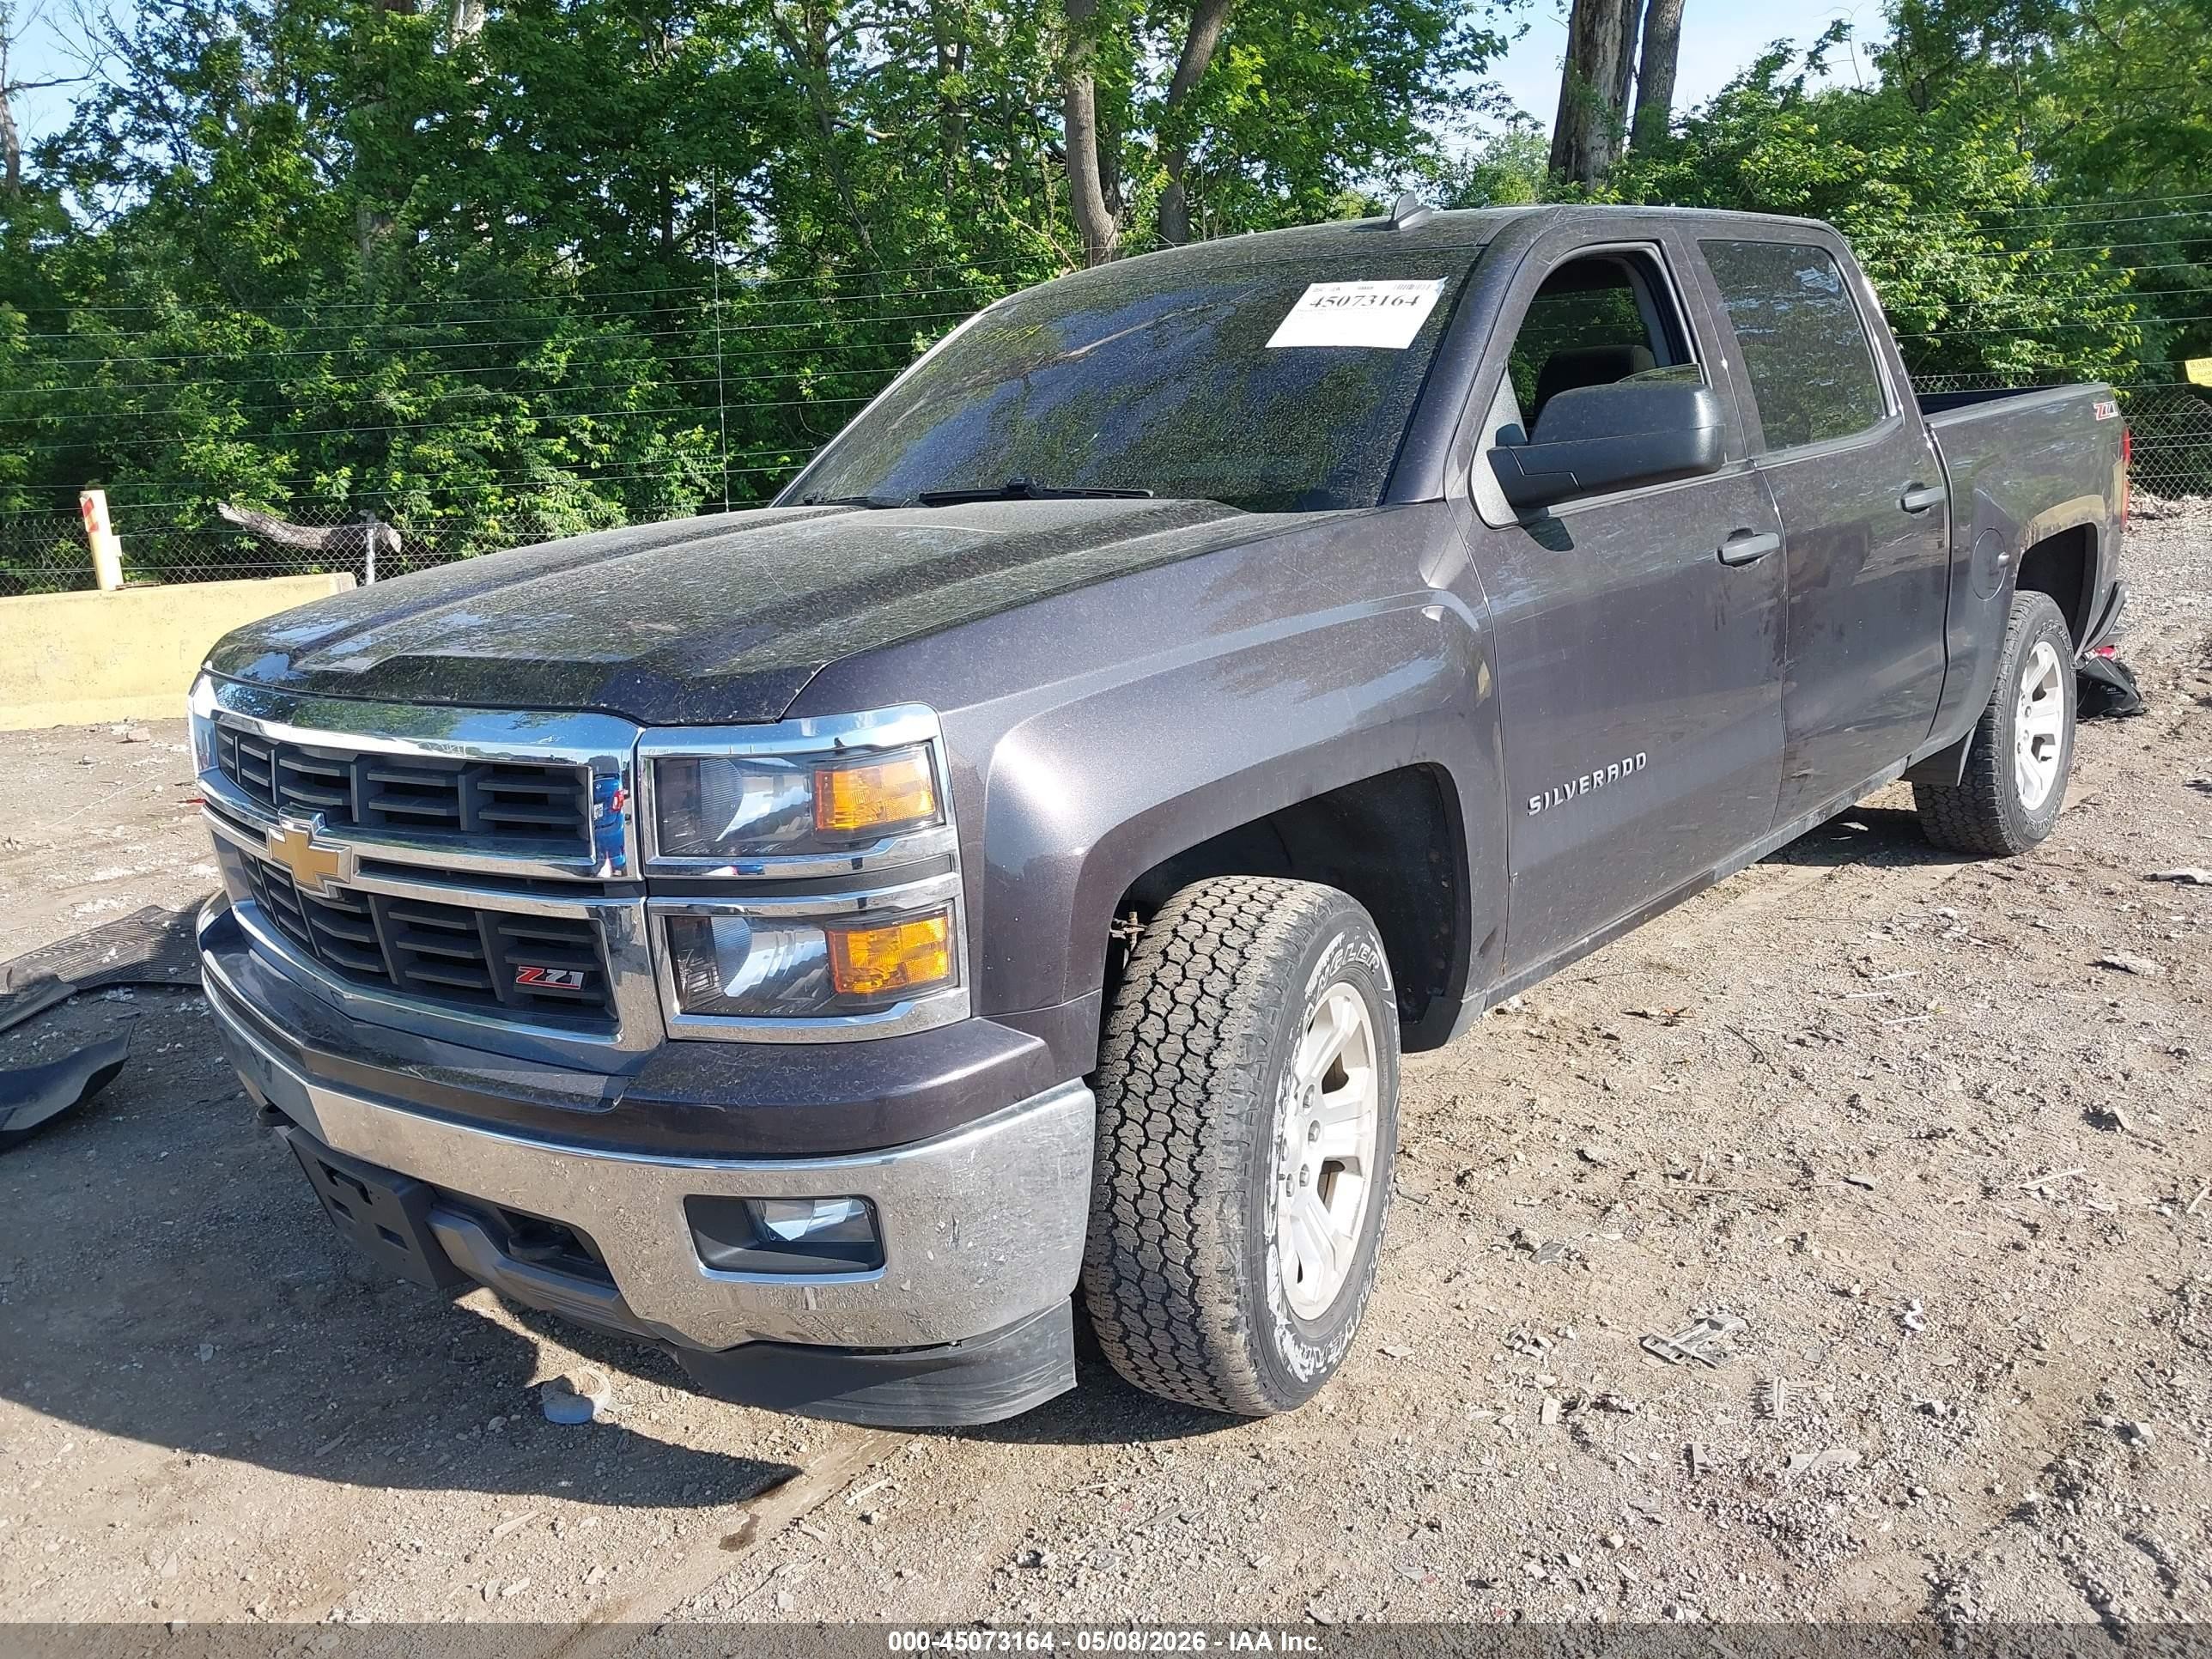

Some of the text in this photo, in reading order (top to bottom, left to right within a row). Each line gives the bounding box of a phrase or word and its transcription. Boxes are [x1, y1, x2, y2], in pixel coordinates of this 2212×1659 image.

[1310, 295, 1420, 307] 45073164
[1527, 751, 1647, 817] SILVERADO
[515, 965, 584, 990] Z71
